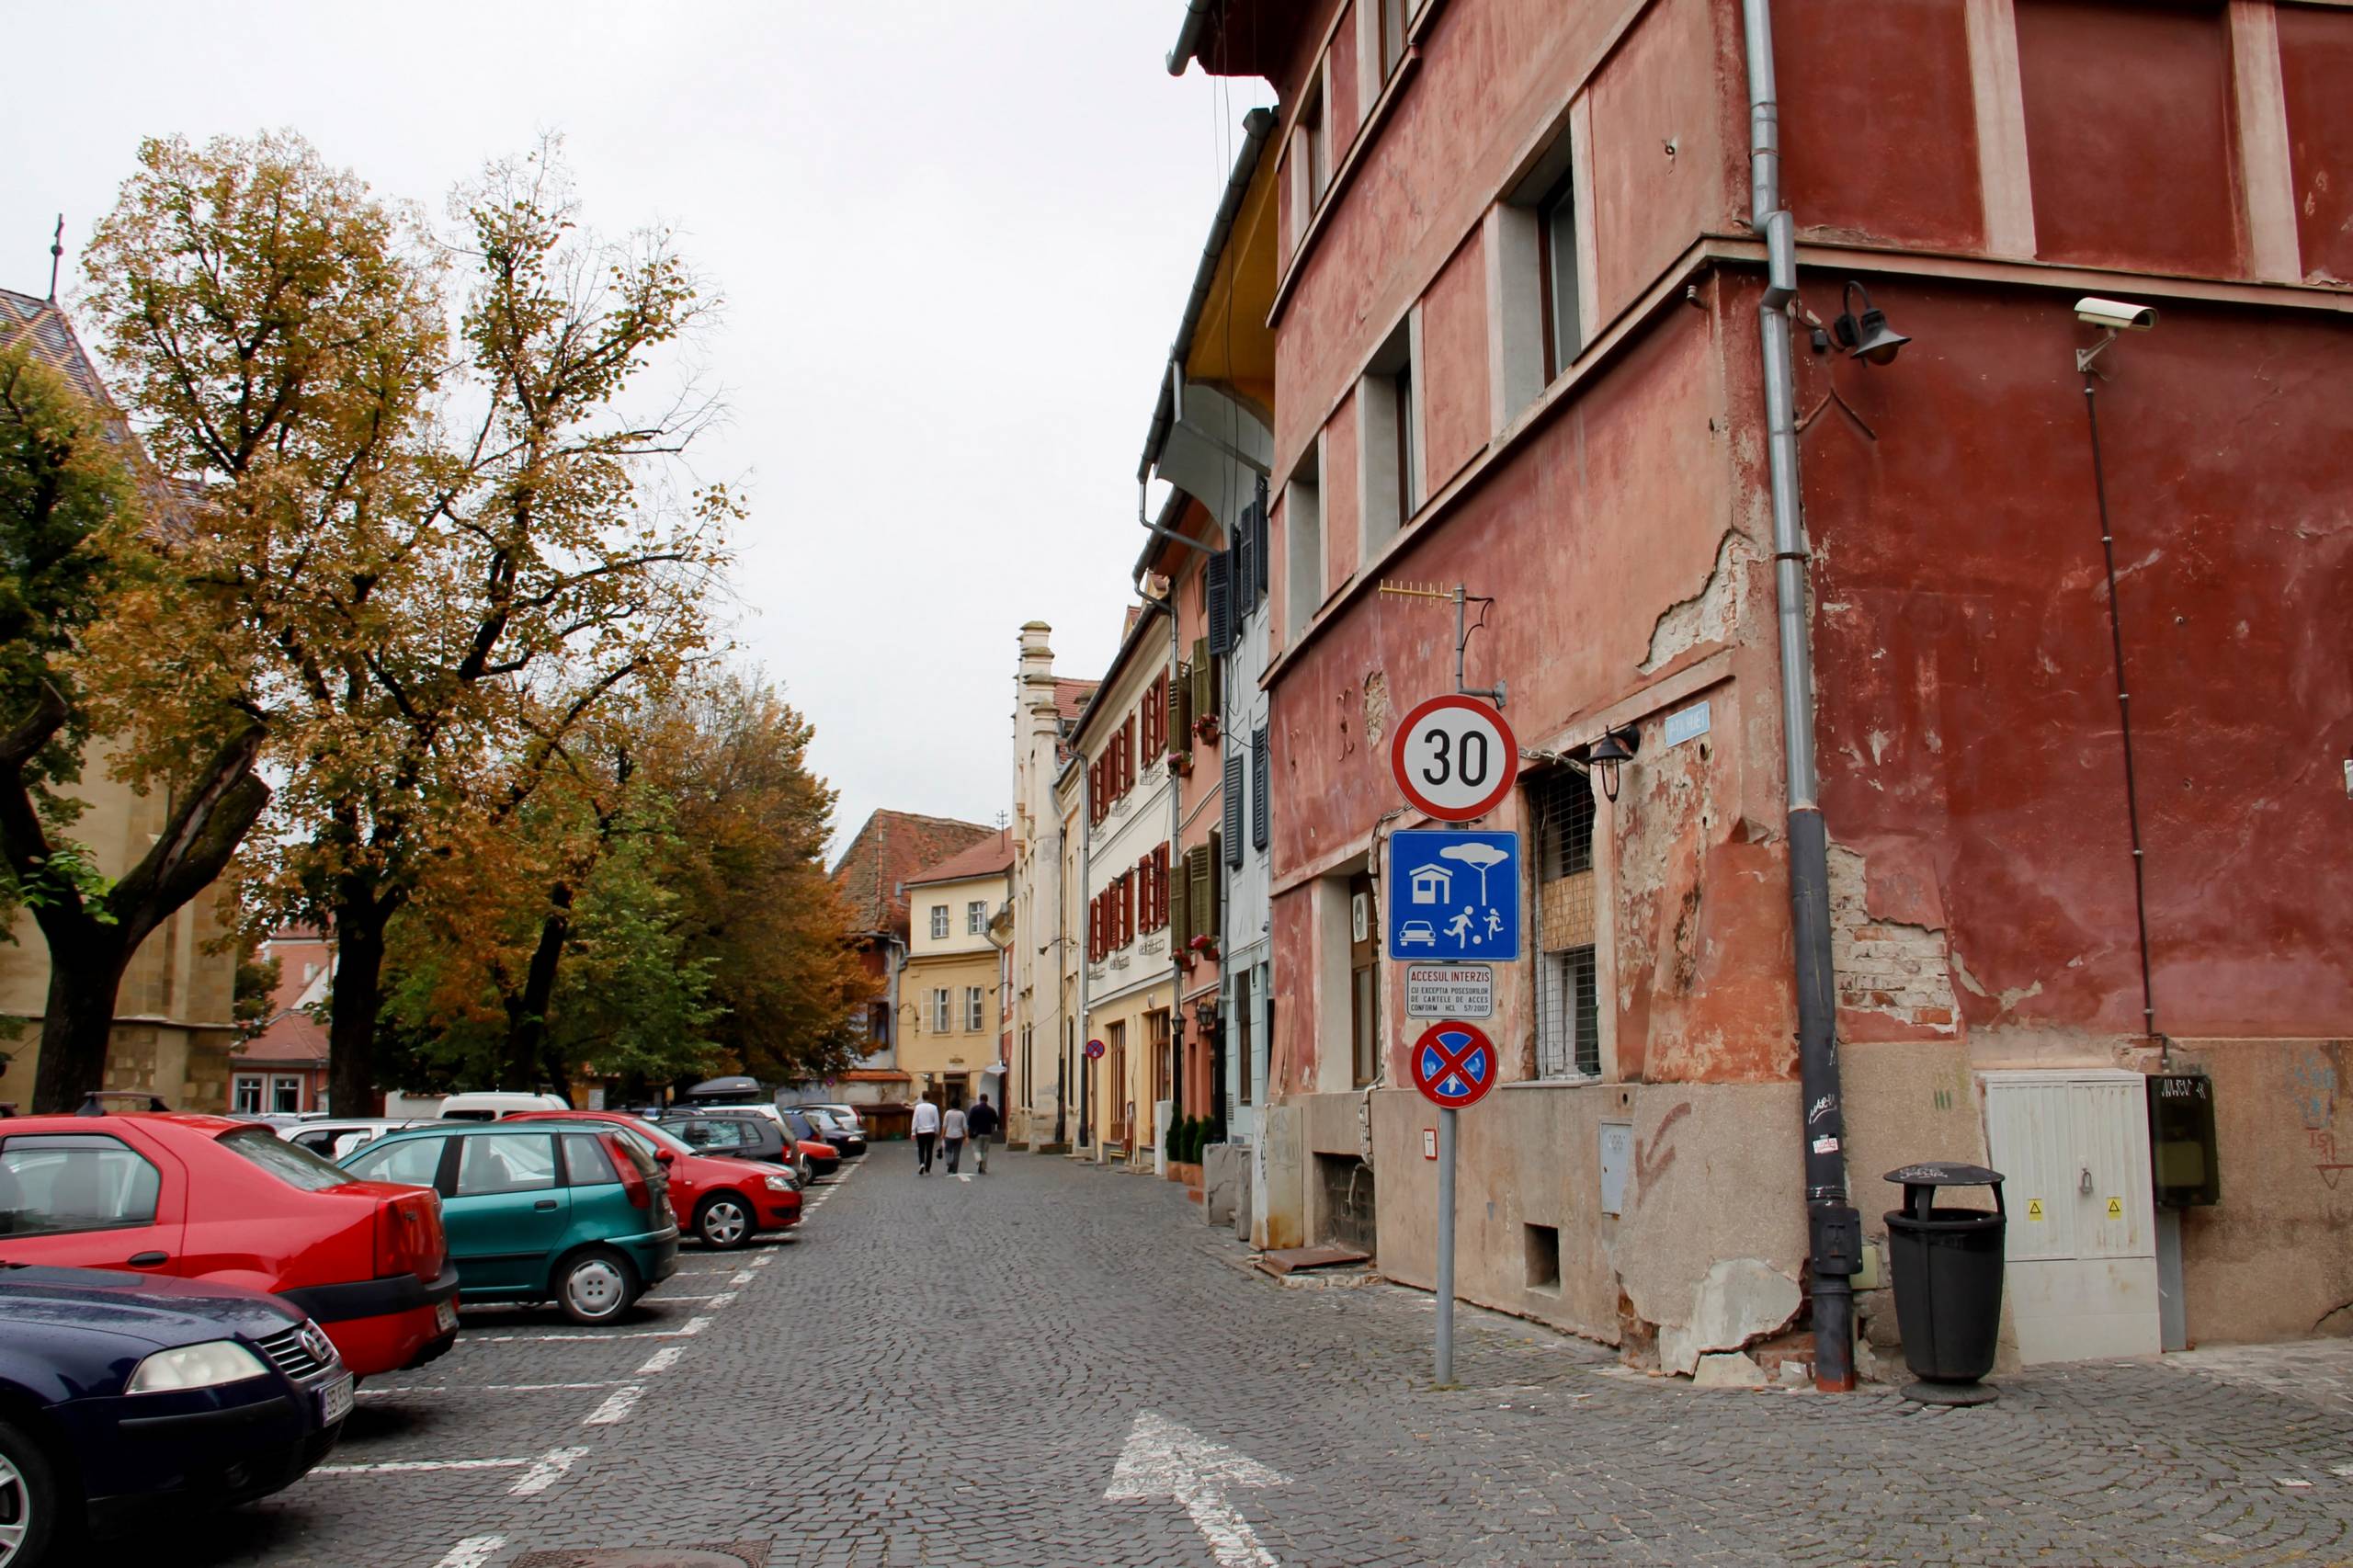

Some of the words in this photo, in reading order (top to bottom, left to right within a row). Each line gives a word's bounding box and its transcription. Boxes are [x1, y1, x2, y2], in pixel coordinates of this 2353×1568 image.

[1423, 729, 1487, 787] 30
[1411, 971, 1449, 982] ACCESUL
[1450, 971, 1490, 983] INTERZIS
